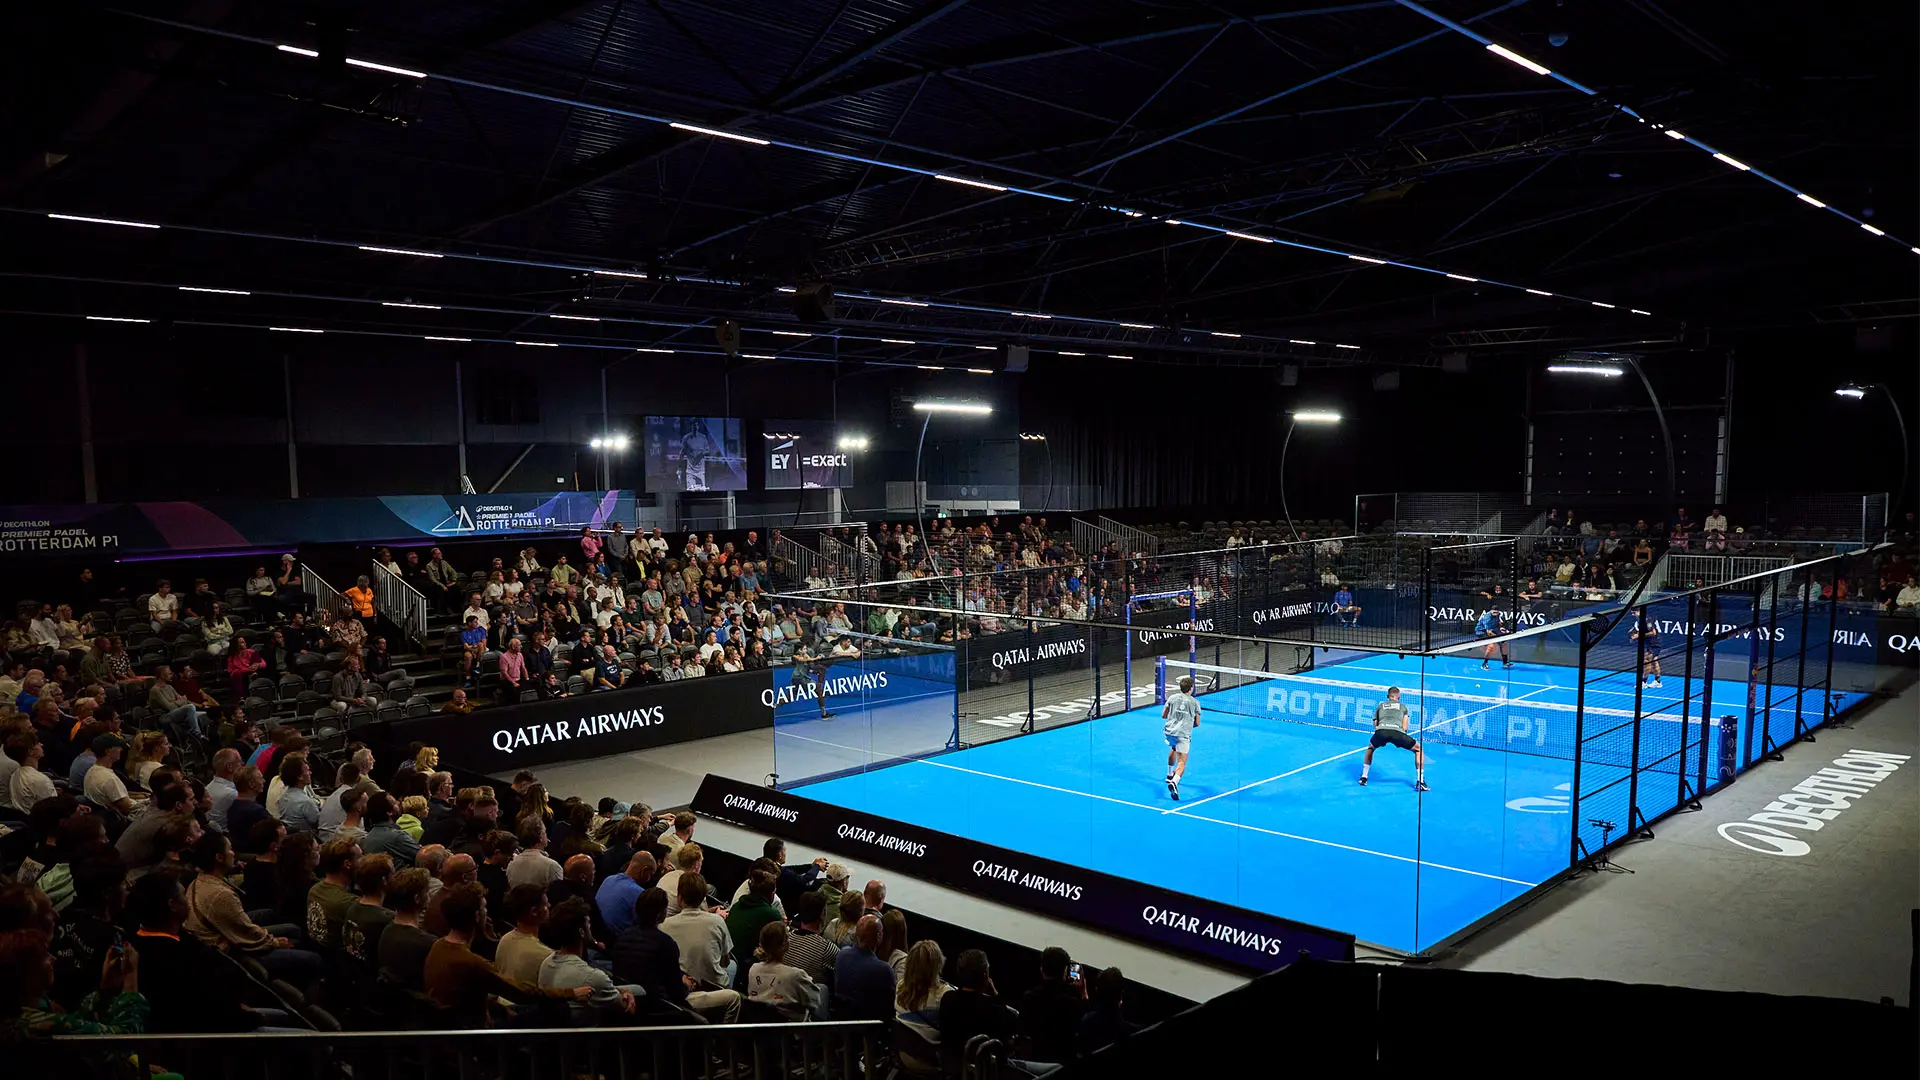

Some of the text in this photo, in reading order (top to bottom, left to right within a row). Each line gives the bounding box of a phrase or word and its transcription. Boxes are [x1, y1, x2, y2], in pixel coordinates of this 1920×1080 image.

[771, 454, 789, 470] EY
[1, 528, 88, 538] PREMIER PADEL
[3, 520, 50, 528] DECATHLON
[102, 535, 118, 547] P1
[1425, 606, 1545, 626] QATAR ARWAYS
[1634, 619, 1696, 636] ATAR
[1037, 638, 1086, 660] AIRWAYS
[761, 671, 888, 708] QATAR AIRWAYS
[1266, 687, 1487, 740] ROTTEDAM
[492, 705, 665, 754] QATAR AIRWAYS
[1747, 749, 1912, 832] DECATHLON
[723, 794, 799, 823] QATAR AIRWAYS
[837, 823, 927, 858] QATAR AIRWAYS
[972, 860, 1083, 901] QATAR AIRWAYS
[1142, 905, 1282, 956] QATAR AIRWAYS
